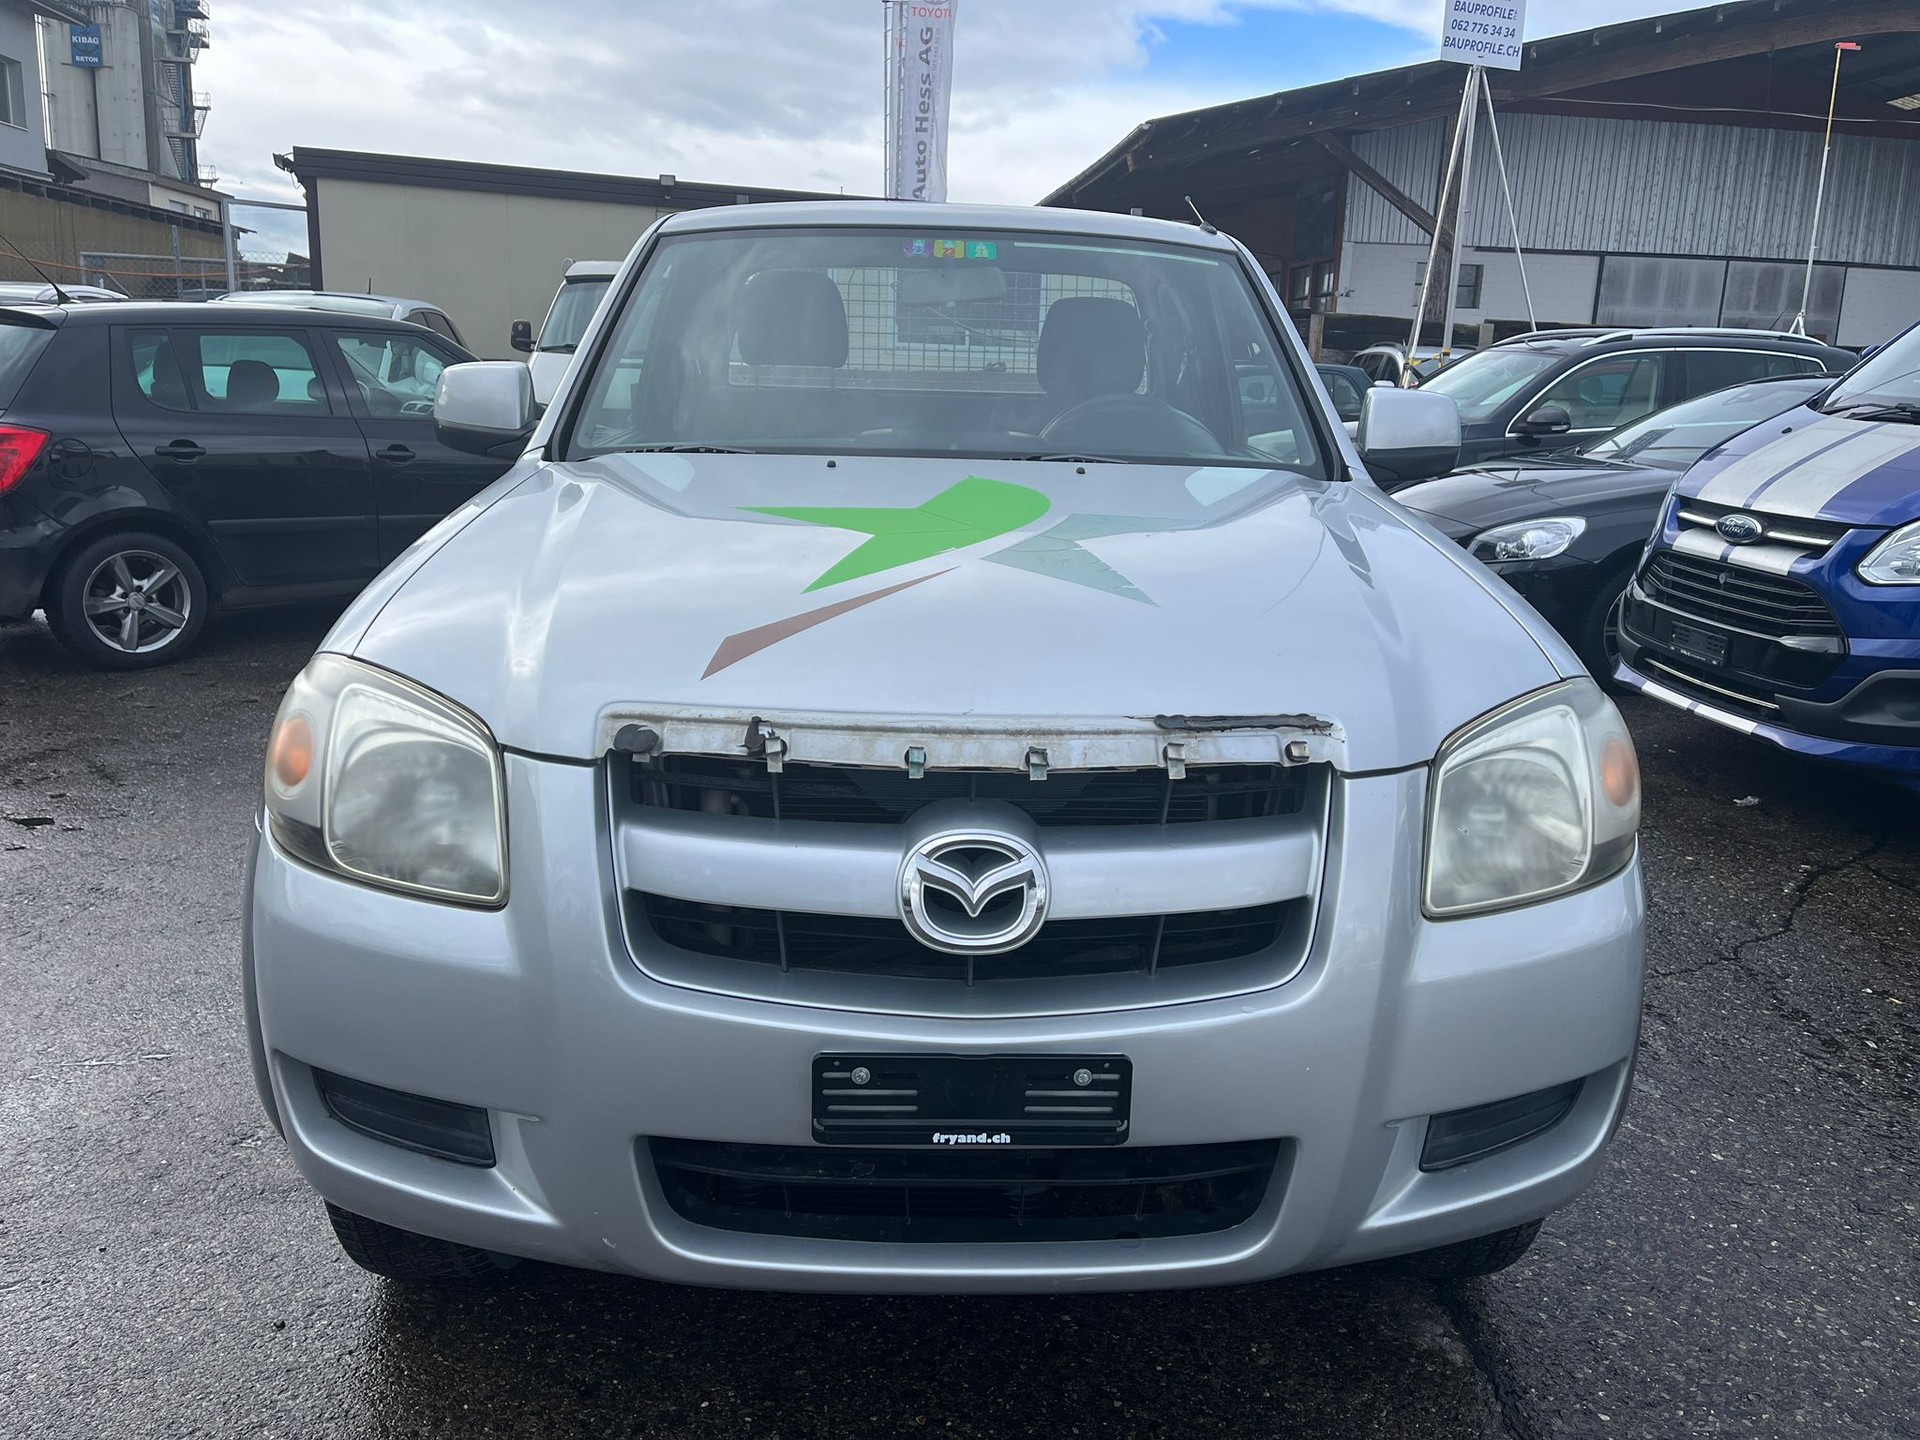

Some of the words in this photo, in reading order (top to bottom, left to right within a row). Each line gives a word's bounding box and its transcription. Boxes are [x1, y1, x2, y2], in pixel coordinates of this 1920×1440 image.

[1454, 0, 1514, 20] BAUPROFILE
[1451, 19, 1469, 31] 062
[1471, 22, 1489, 35] 776
[1490, 25, 1502, 36] 34
[1503, 27, 1516, 38] 34
[918, 26, 933, 66] AG
[1443, 36, 1520, 57] BAUPROFILE.CH
[915, 73, 931, 133] Hess
[912, 139, 927, 201] Auto
[932, 1132, 1011, 1145] fryand.ch
